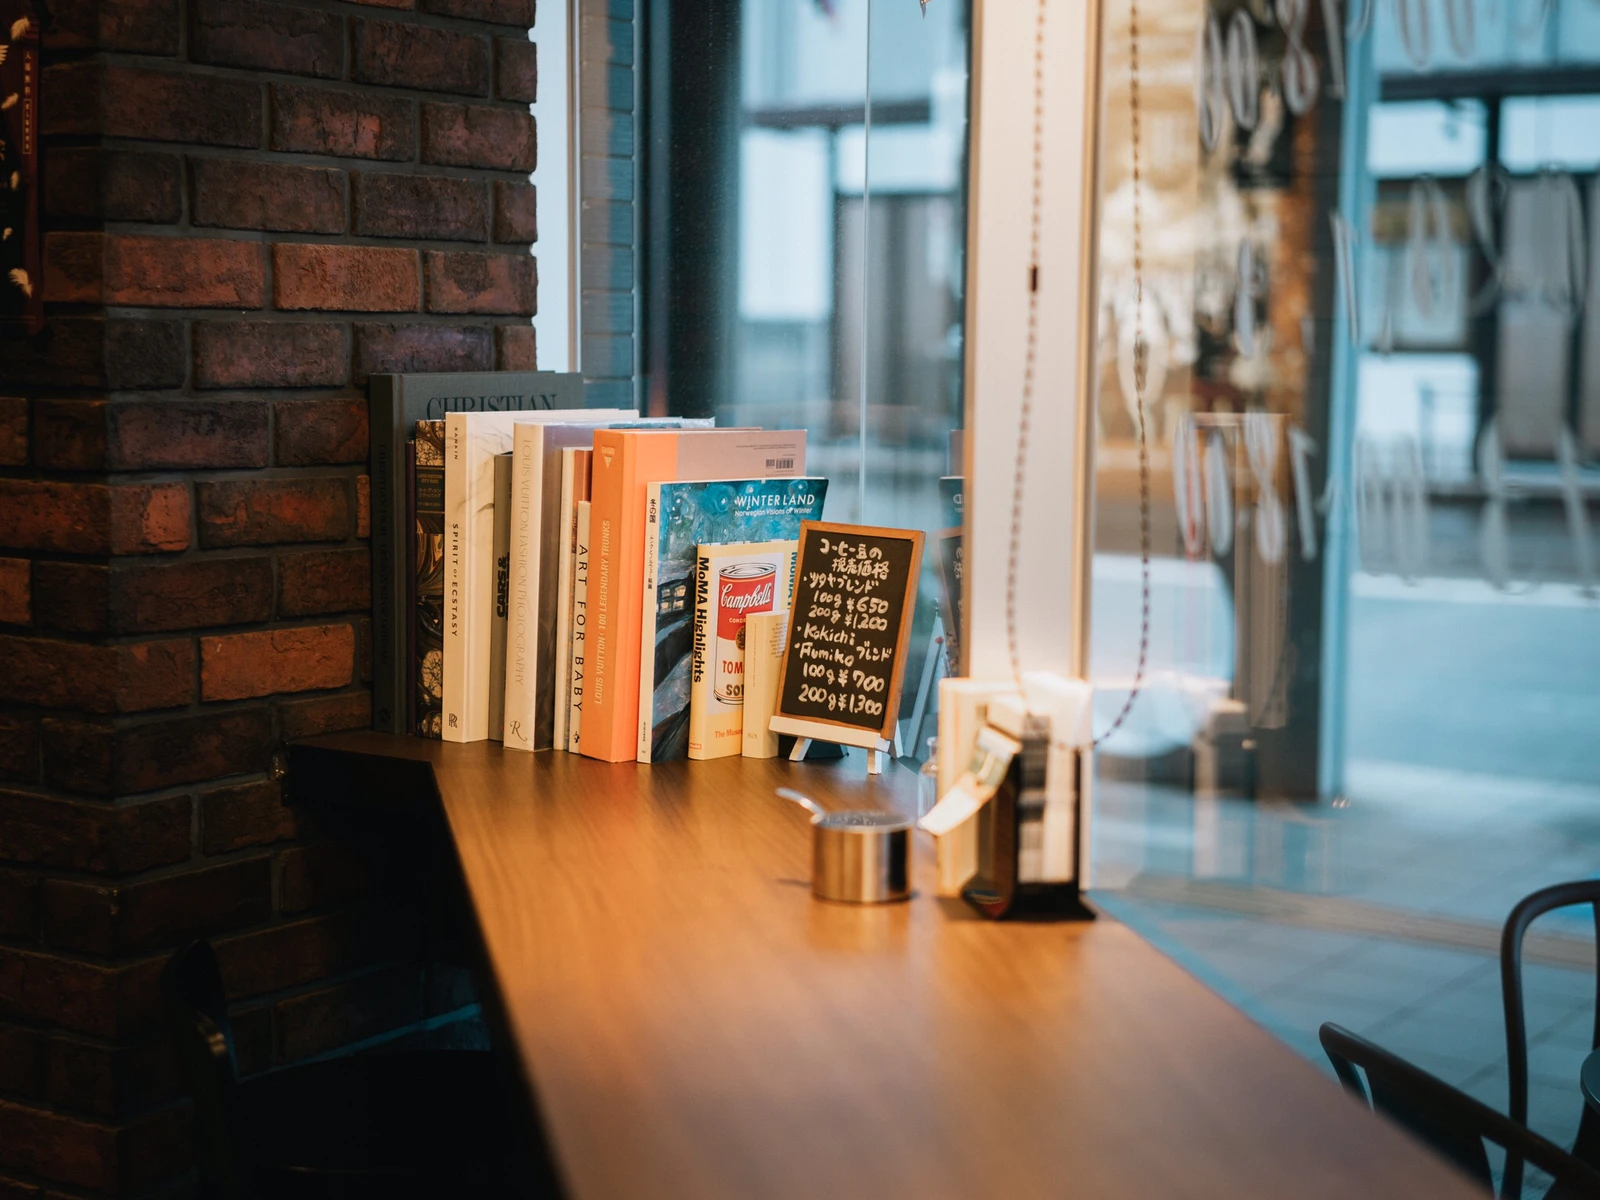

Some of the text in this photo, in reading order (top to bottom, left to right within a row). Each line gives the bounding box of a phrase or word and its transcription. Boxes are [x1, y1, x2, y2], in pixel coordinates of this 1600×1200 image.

[734, 509, 765, 517] Norwegian
[601, 520, 610, 556] TRUNKS
[820, 538, 882, 560] コーヒー豆の
[514, 439, 532, 685] LOUIS VUITTON FASHION PHOTOGRAPHY
[497, 570, 506, 617] CARS
[599, 558, 609, 612] LEGENDARY
[808, 604, 841, 624] 200g
[814, 590, 889, 614] 100g ¥650
[573, 544, 588, 711] ART FOR BABY
[693, 556, 710, 683] MoMA Highlights
[722, 660, 745, 674] TOM
[803, 662, 885, 692] 100g ¥700
[594, 677, 603, 705] LOUIS
[798, 684, 836, 711] 200g
[714, 731, 726, 739] The
